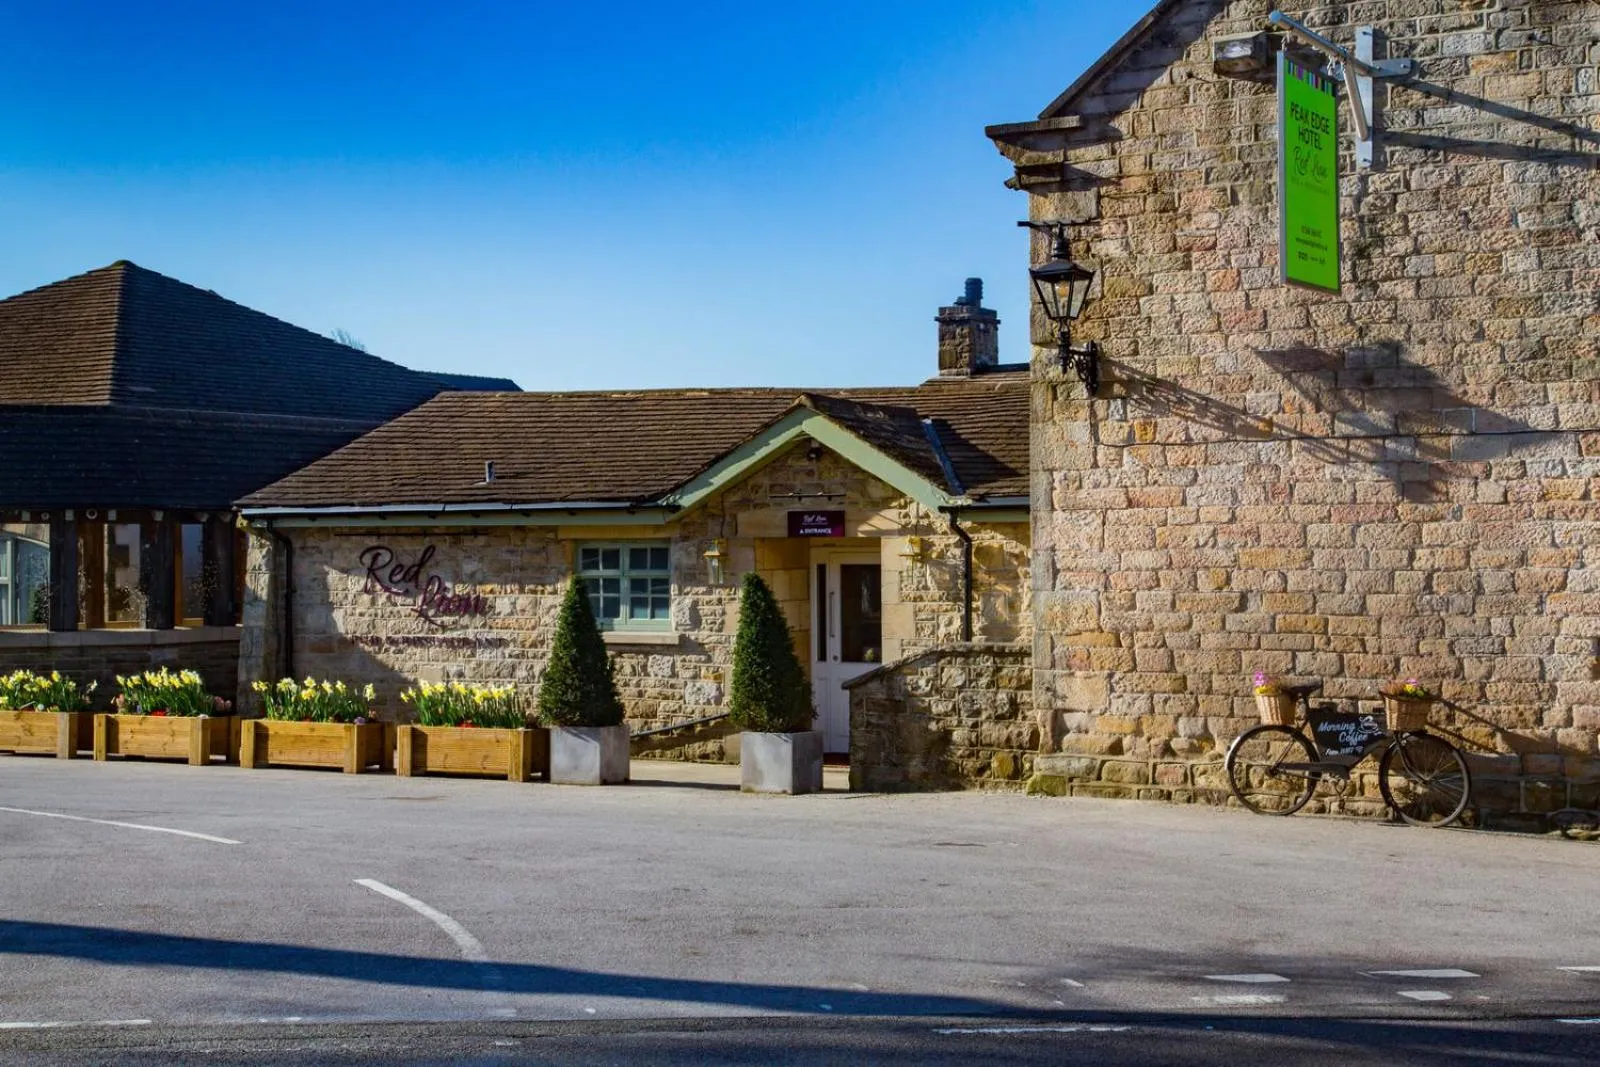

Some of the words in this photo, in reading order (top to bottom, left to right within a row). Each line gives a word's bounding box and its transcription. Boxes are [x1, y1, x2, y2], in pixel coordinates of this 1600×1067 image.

[1290, 101, 1310, 124] PEAK
[1311, 111, 1330, 135] EDGE
[1299, 126, 1323, 150] HOTEL
[1293, 145, 1311, 176] Red
[359, 544, 436, 595] Red
[411, 575, 487, 628] Lion
[1317, 721, 1356, 735] Morning
[1339, 731, 1368, 746] Coffee
